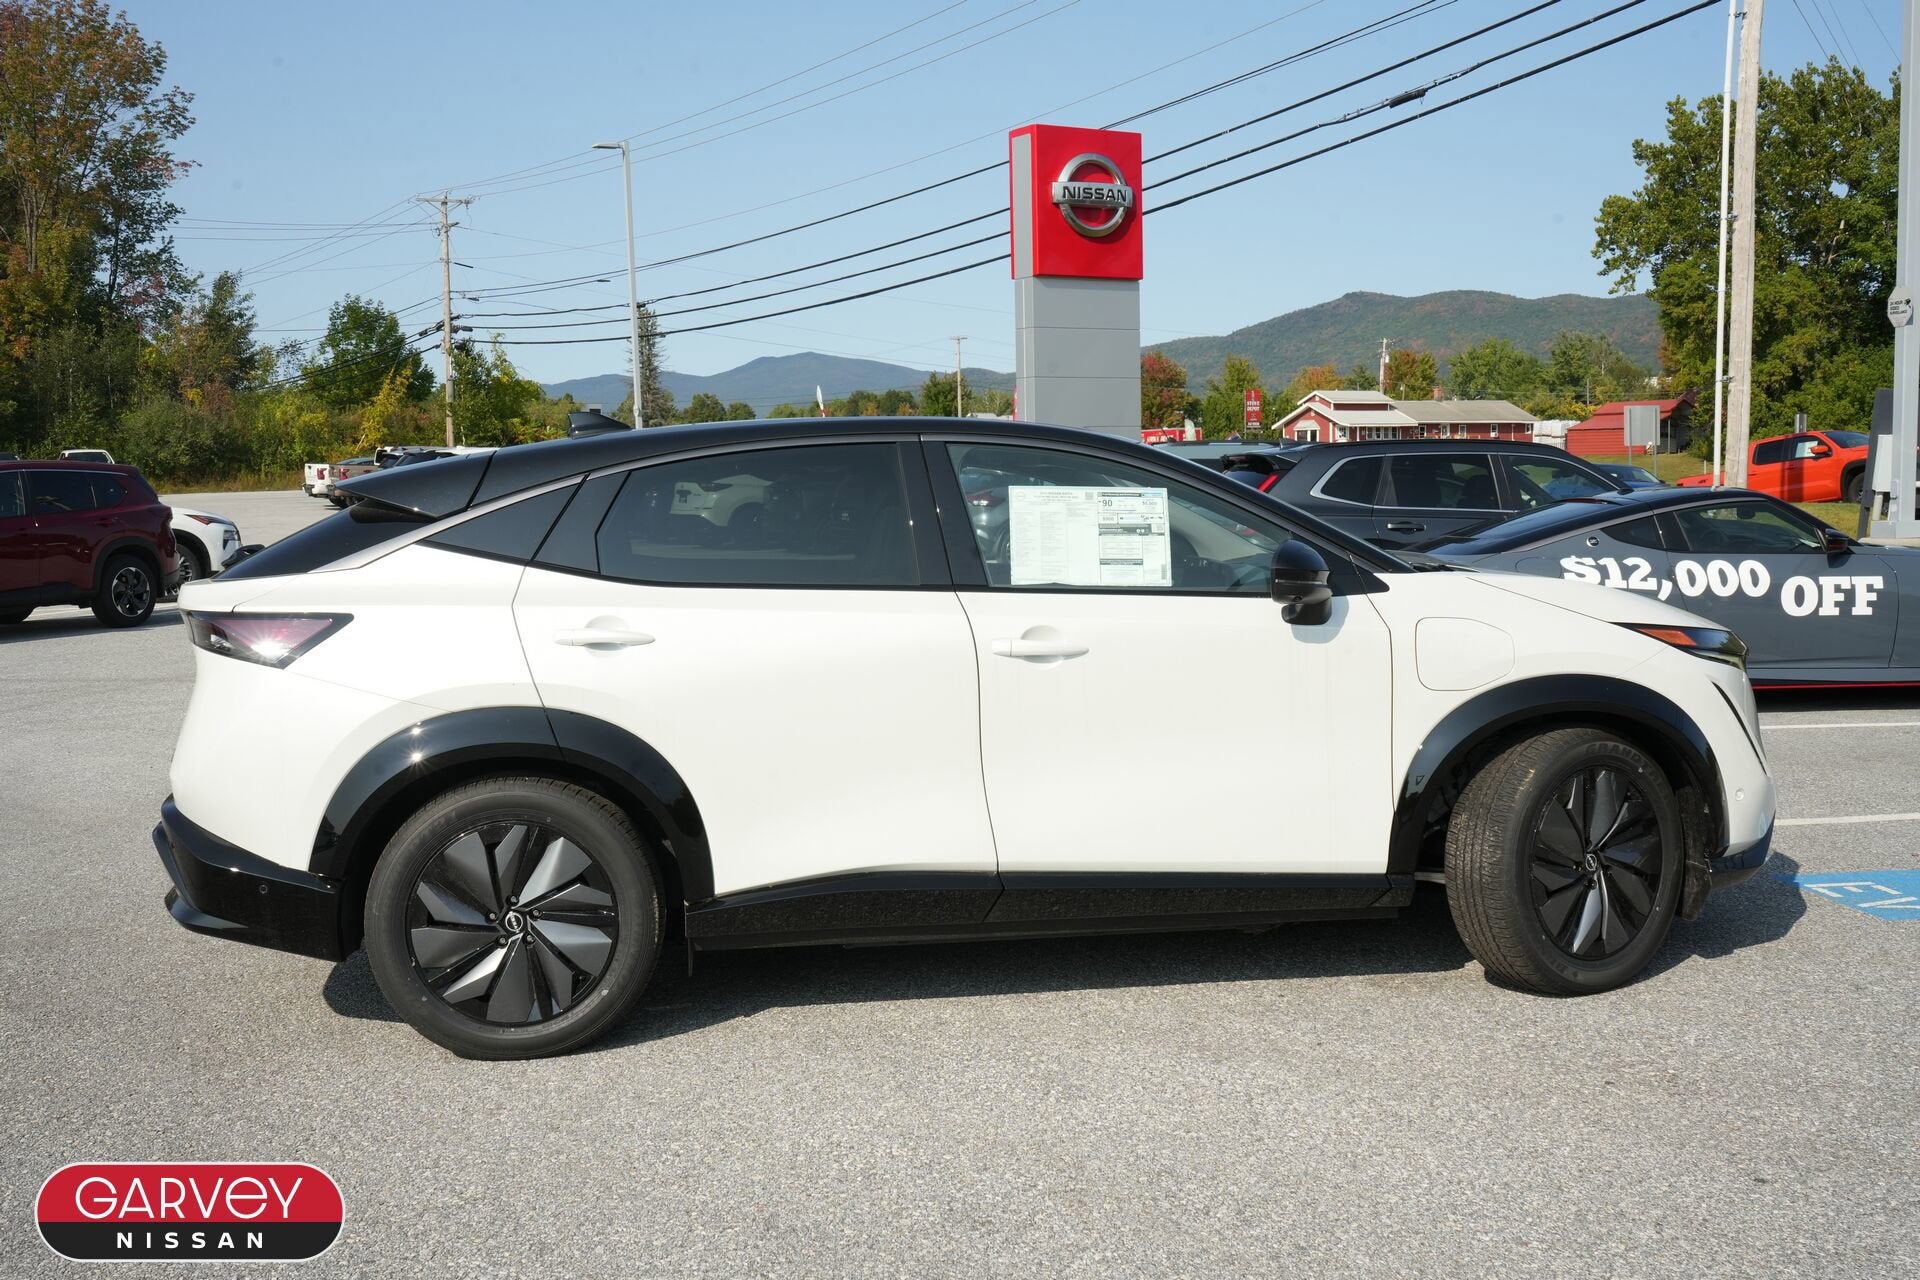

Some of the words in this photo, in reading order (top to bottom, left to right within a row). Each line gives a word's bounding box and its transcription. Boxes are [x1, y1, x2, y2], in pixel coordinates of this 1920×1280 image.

[1062, 185, 1127, 203] NISSAN
[1559, 555, 1771, 601] $12,000
[1780, 575, 1884, 617] OFF
